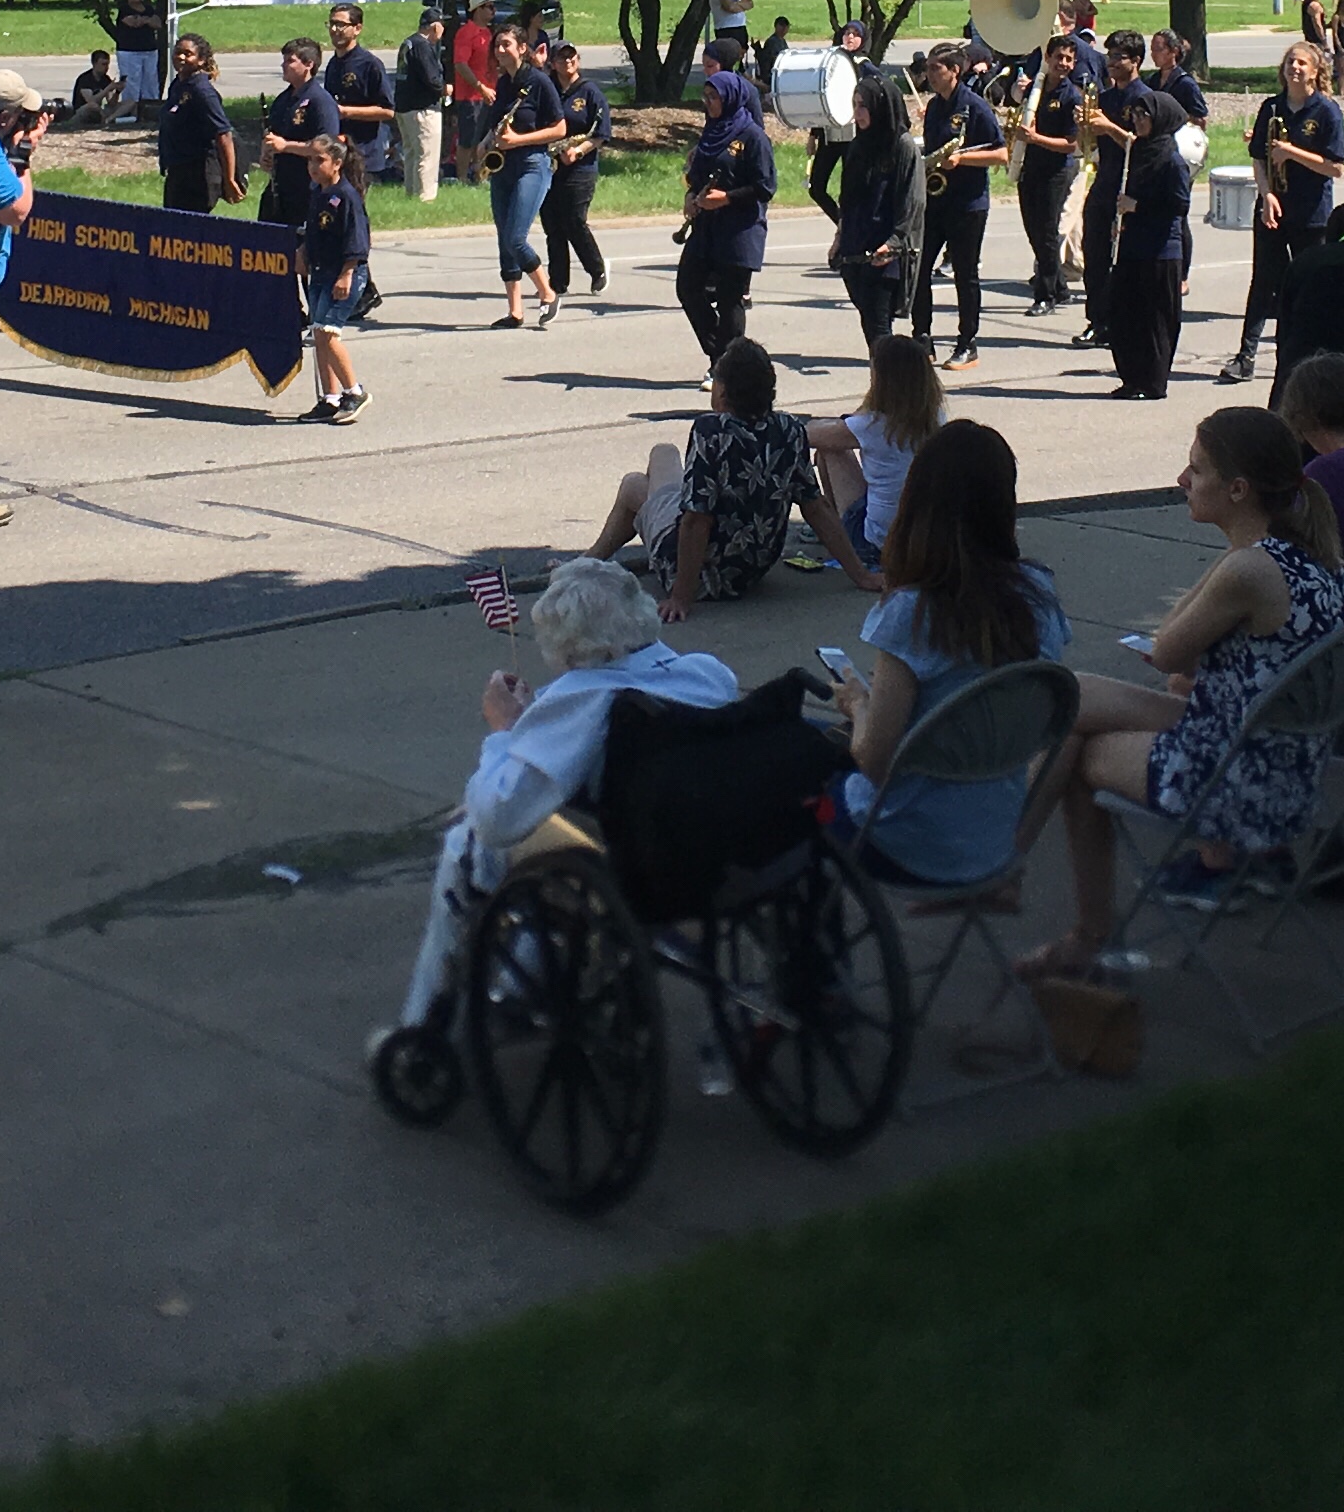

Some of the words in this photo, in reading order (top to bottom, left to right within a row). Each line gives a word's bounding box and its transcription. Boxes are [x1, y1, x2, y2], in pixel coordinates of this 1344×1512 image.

[27, 217, 66, 244] HIGH
[75, 225, 140, 254] SCHOOL
[149, 235, 233, 268] MARCHING
[241, 248, 288, 276] BAND
[128, 297, 210, 331] MICHIGAN
